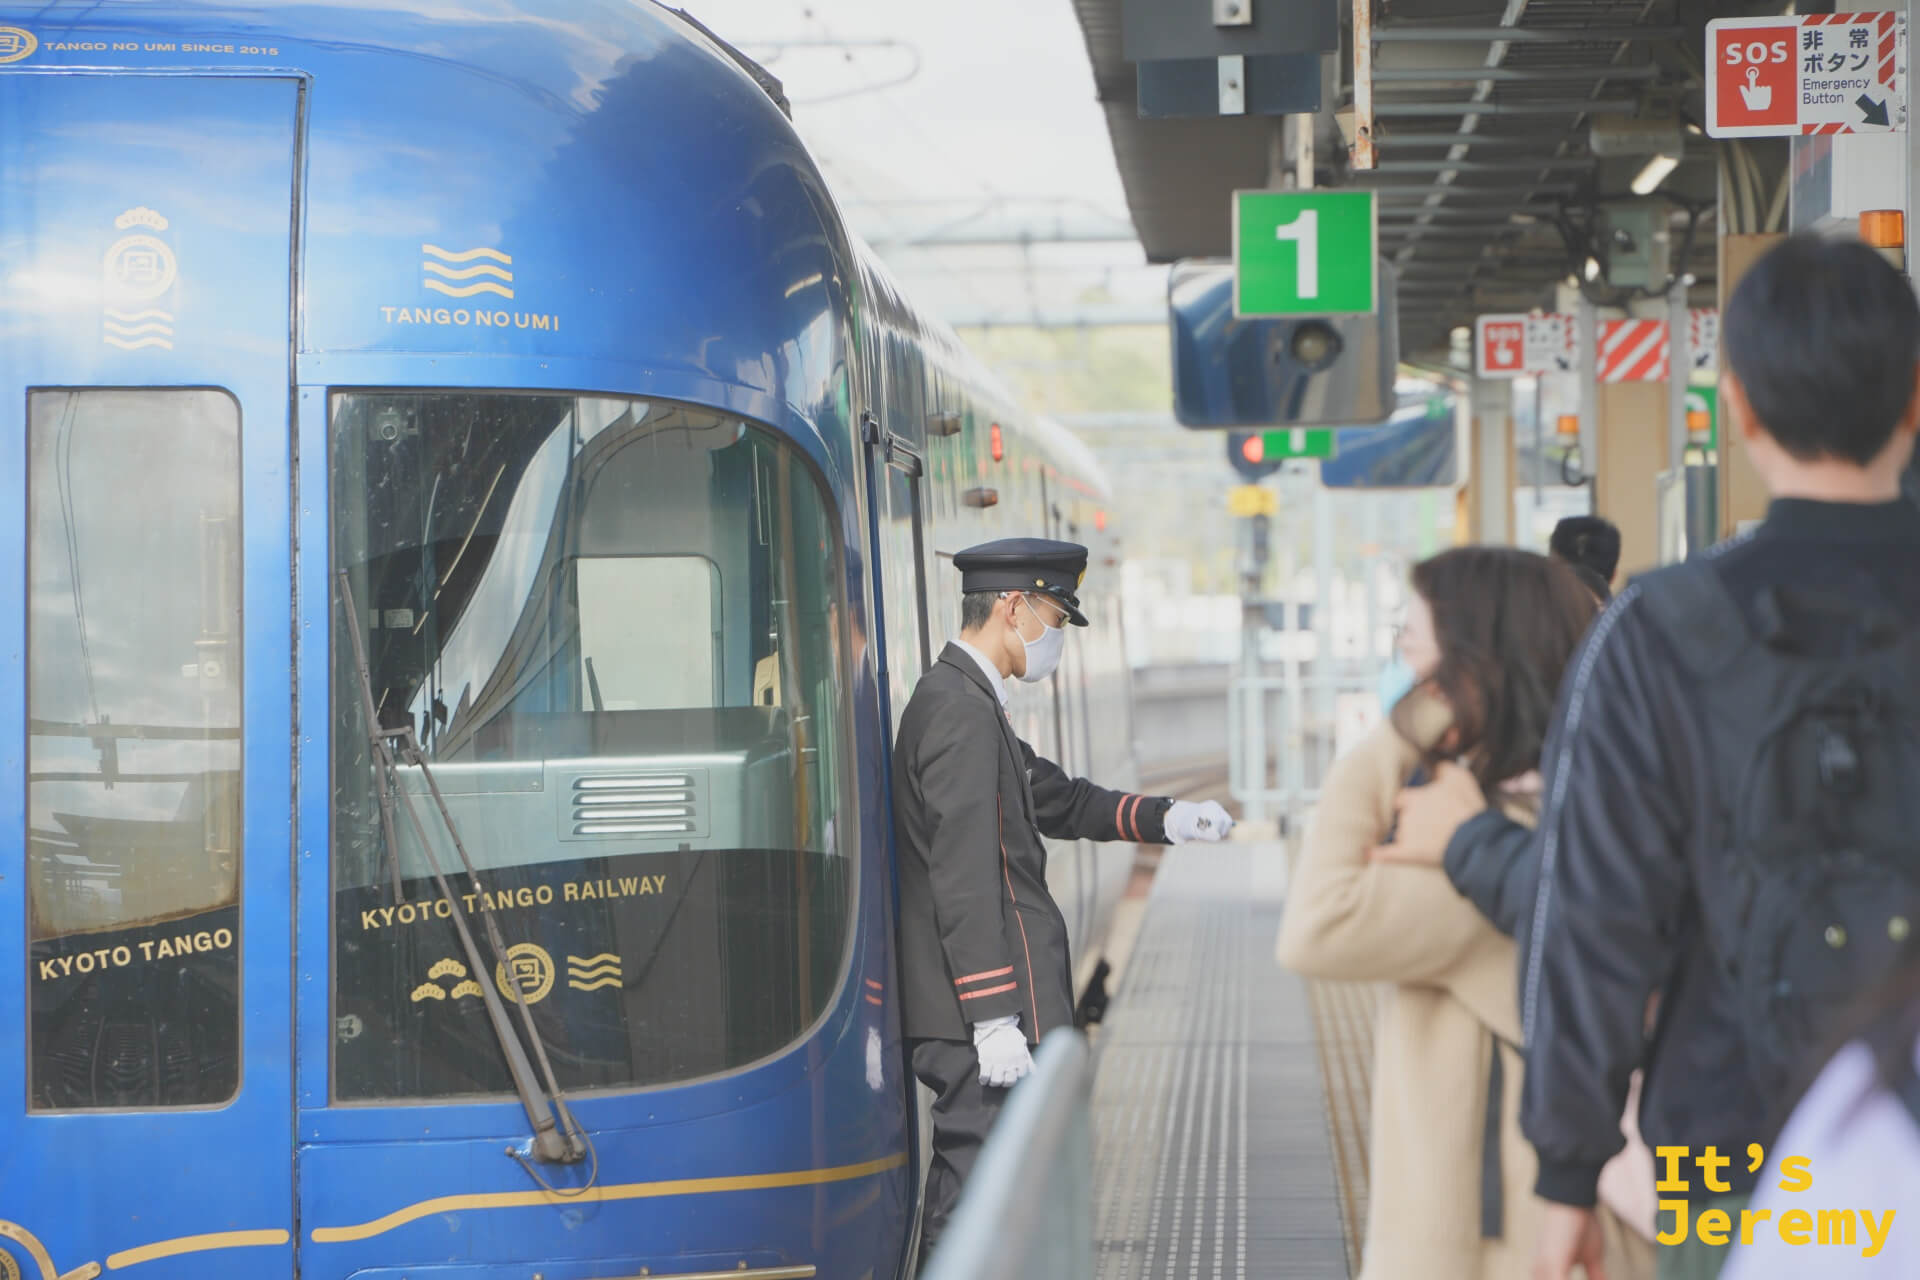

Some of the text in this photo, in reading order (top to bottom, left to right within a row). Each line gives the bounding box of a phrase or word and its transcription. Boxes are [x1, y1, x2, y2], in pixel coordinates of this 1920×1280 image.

[44, 41, 279, 57] TANGO NO UMI SINCE 2015
[1725, 41, 1789, 65] SOS
[1803, 52, 1871, 74] ボタン
[1802, 78, 1871, 90] Emergency
[1802, 93, 1844, 105] Button
[1276, 209, 1318, 299] 1
[380, 306, 559, 332] TANGO NO UMI
[361, 875, 667, 930] KYOTO TANGO RAILWAY
[39, 928, 233, 981] KYOTO TANGO
